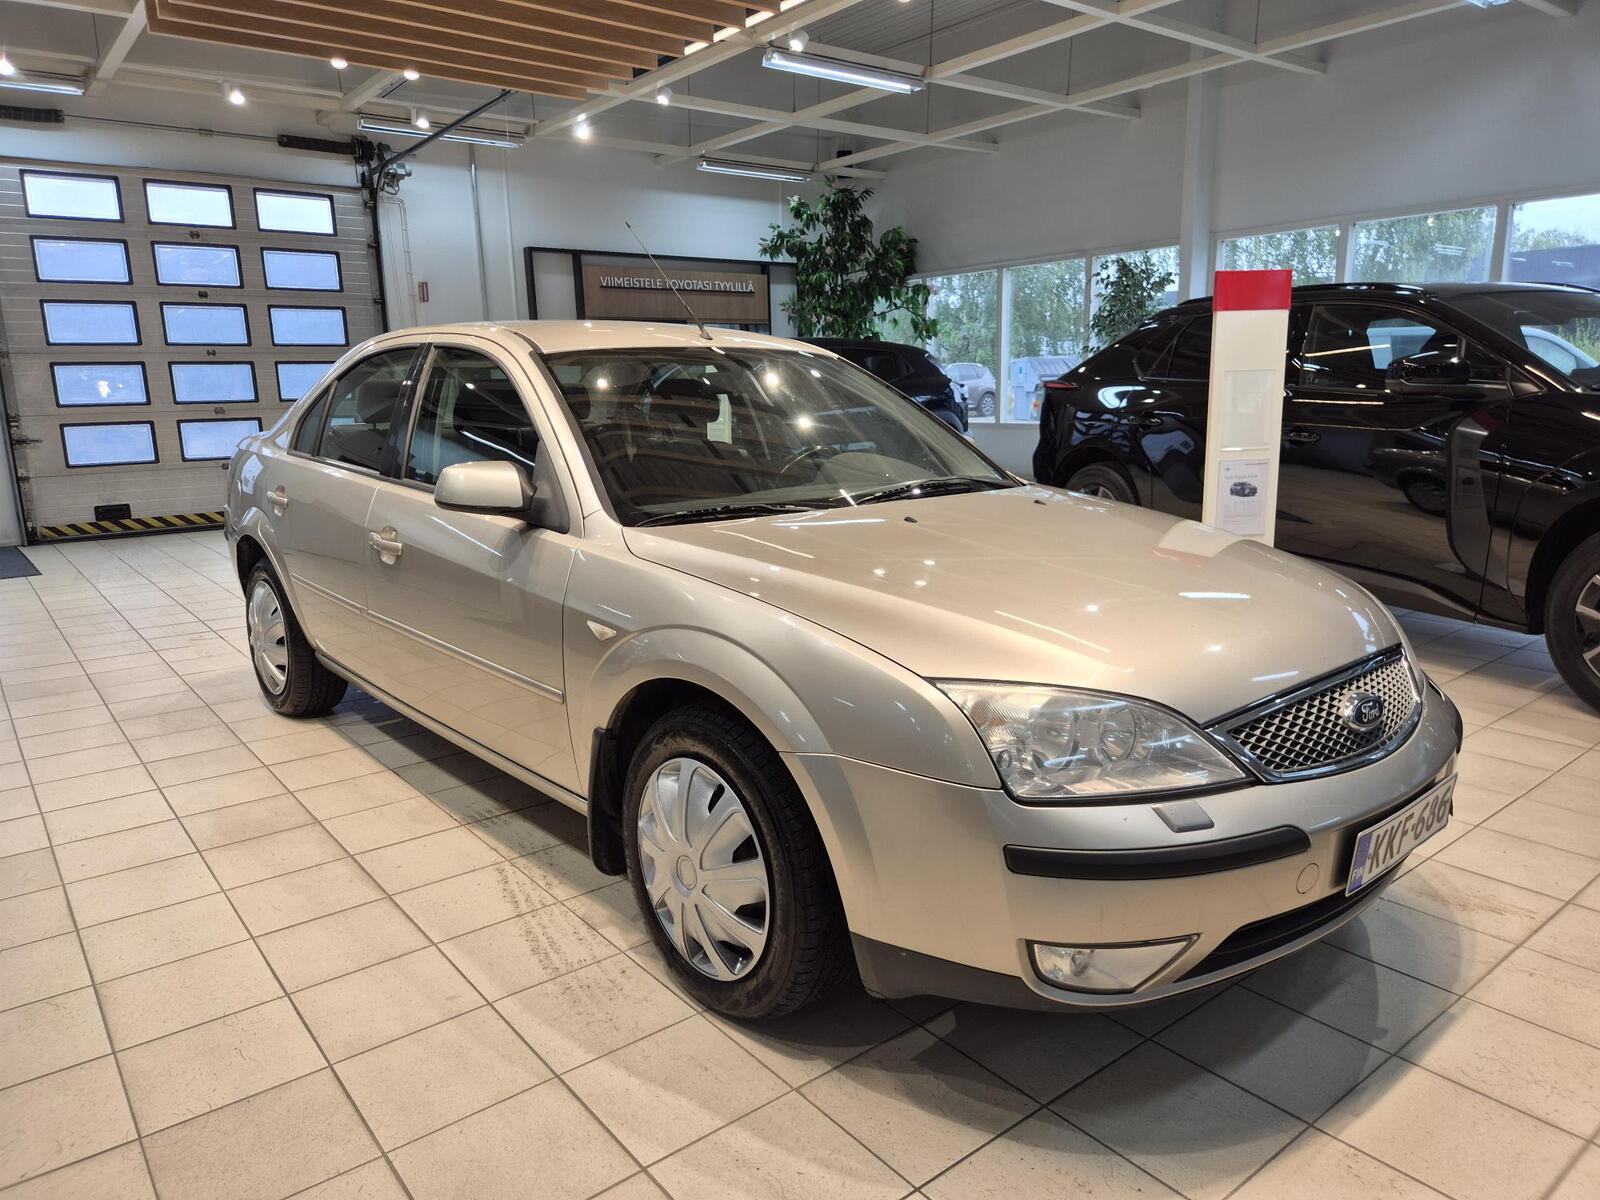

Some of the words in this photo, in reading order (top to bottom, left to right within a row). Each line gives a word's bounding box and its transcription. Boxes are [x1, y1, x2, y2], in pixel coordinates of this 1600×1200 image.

[600, 276, 662, 289] VIIMEISTELE
[665, 279, 712, 291] TOYOTASI
[715, 281, 755, 292] TYYLILLÄ
[1361, 701, 1380, 722] Ford
[1368, 785, 1452, 874] KKF-686
